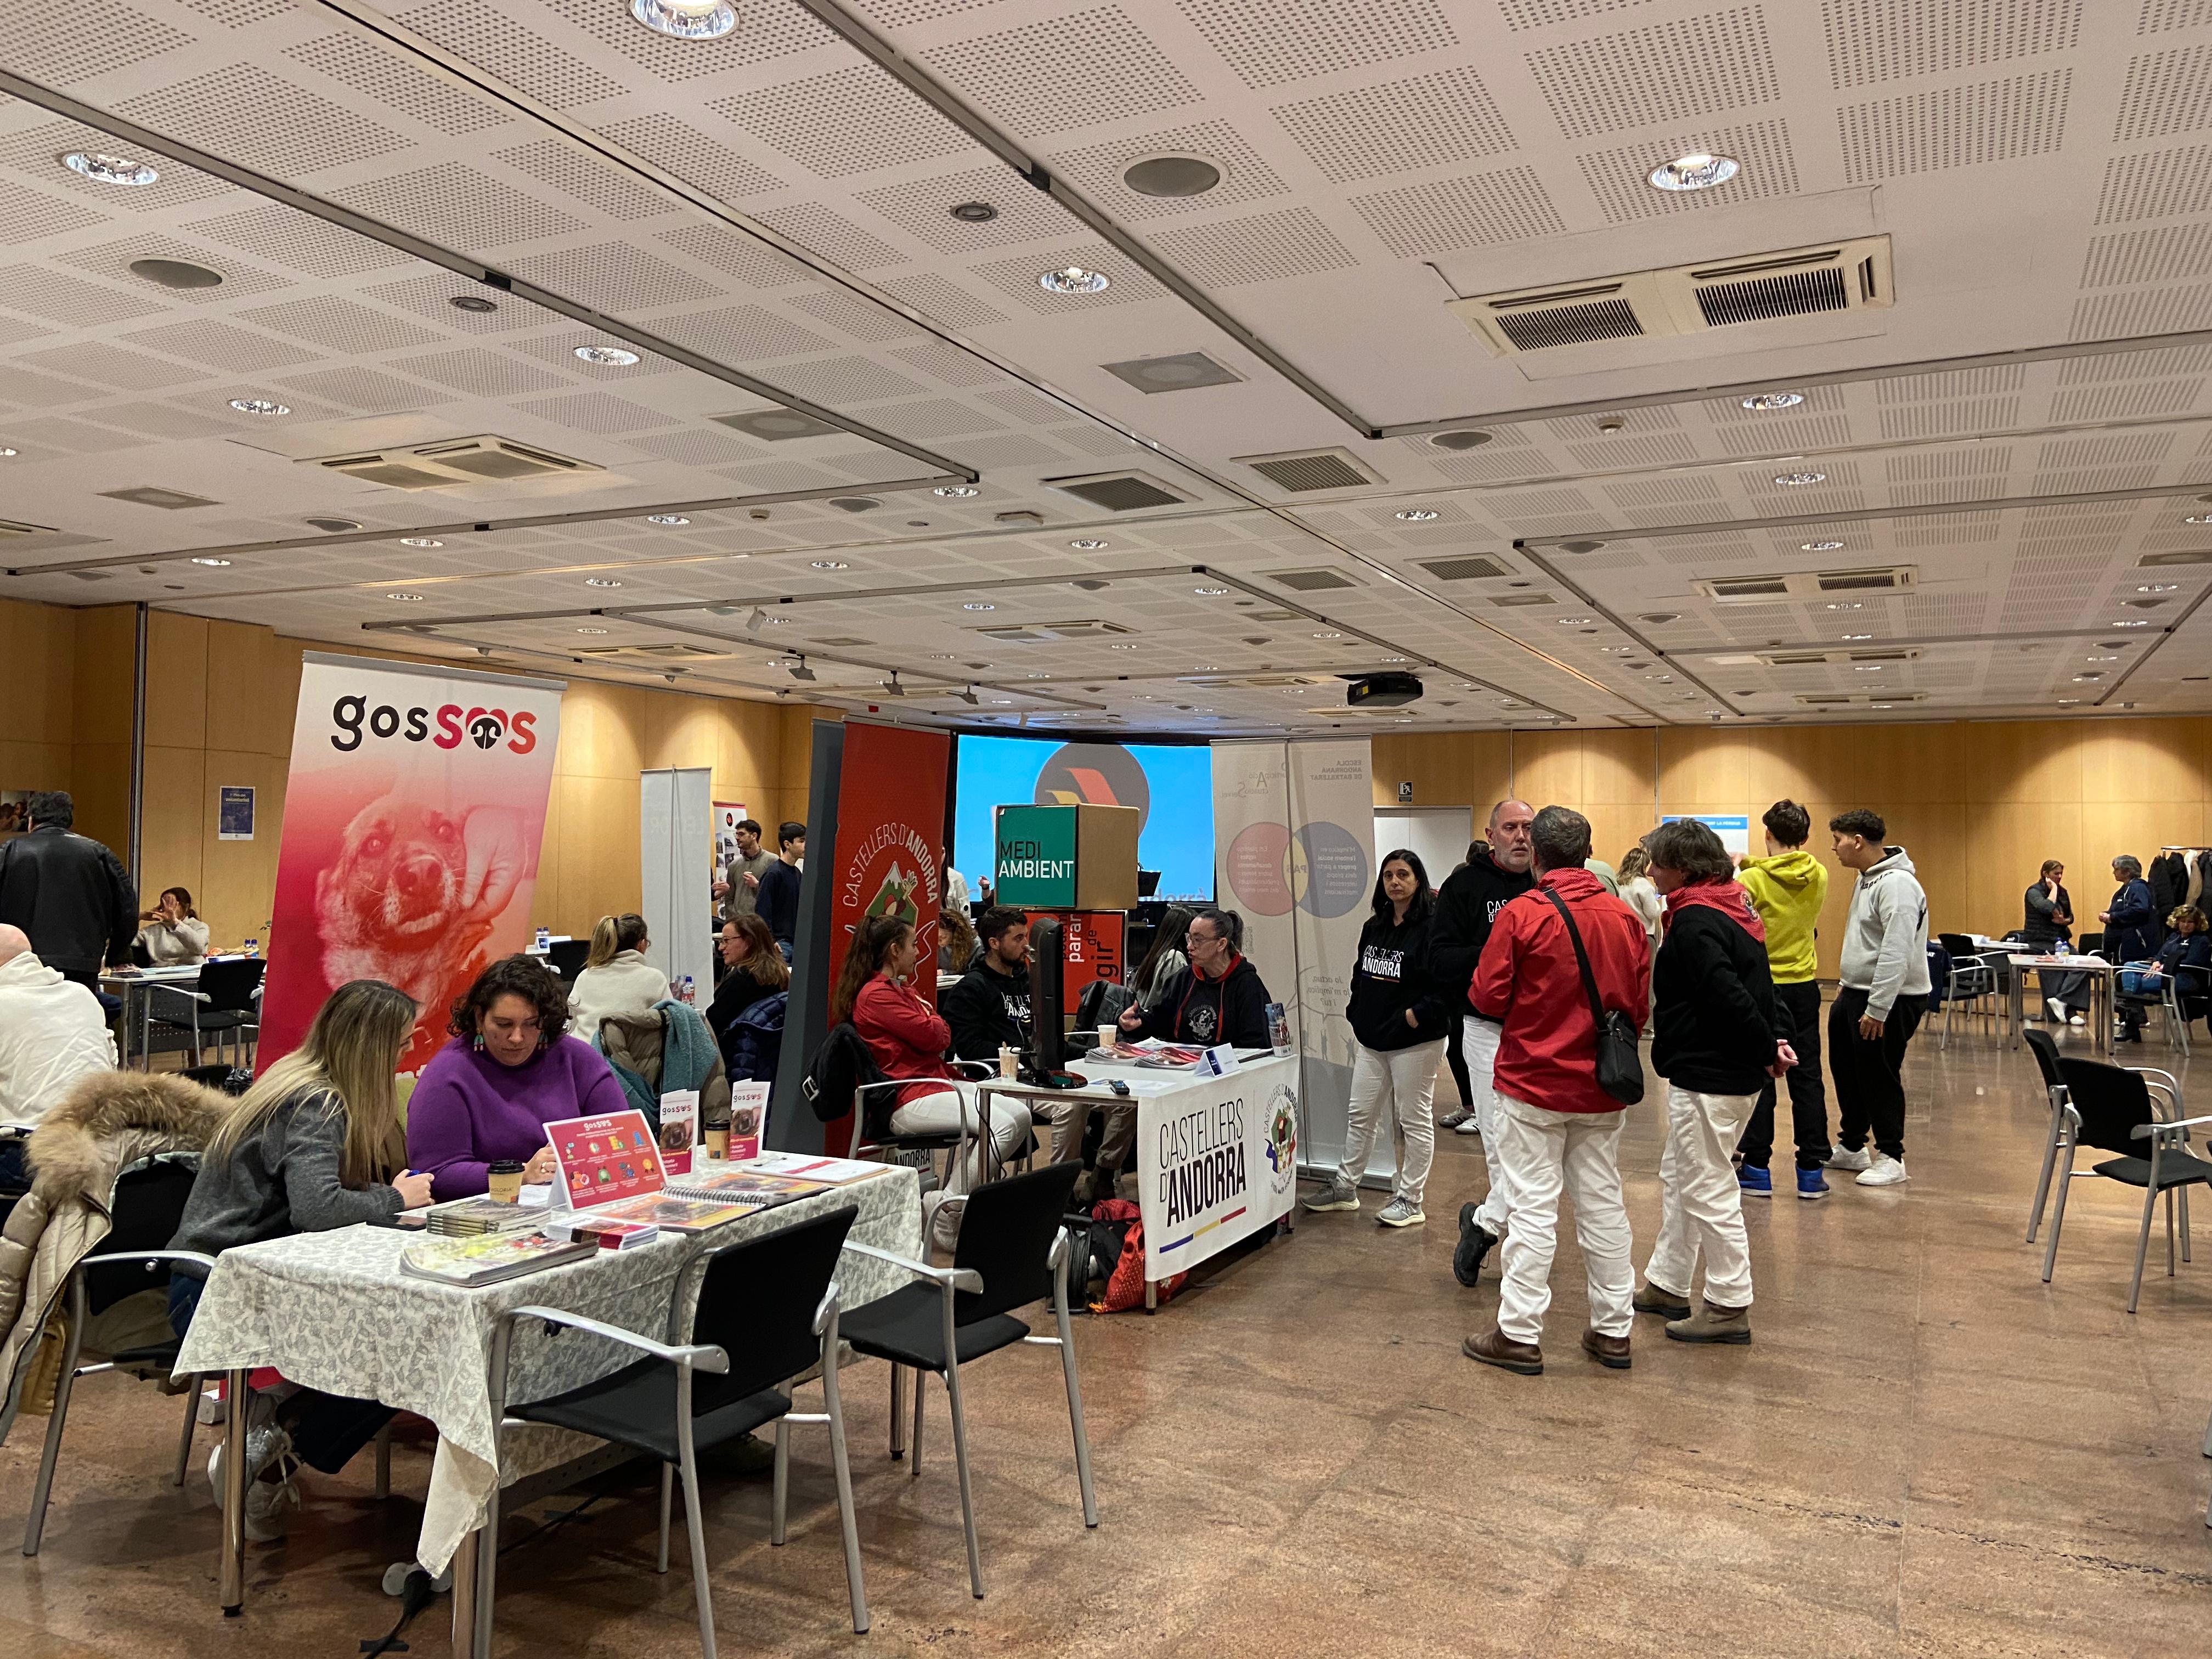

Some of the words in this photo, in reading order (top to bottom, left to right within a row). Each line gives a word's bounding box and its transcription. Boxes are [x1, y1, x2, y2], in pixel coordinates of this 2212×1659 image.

[843, 822, 896, 907] CASTELLERS
[899, 823, 938, 904] D'ANDORRA
[1000, 841, 1041, 859] MEDI
[998, 860, 1074, 878] AMBIENT
[1069, 914, 1084, 962] parar
[1085, 930, 1097, 946] de
[1362, 956, 1401, 978] ANDORRA
[1159, 1098, 1244, 1170] CASTELLERS
[1159, 1141, 1246, 1228] D'ANDORRA
